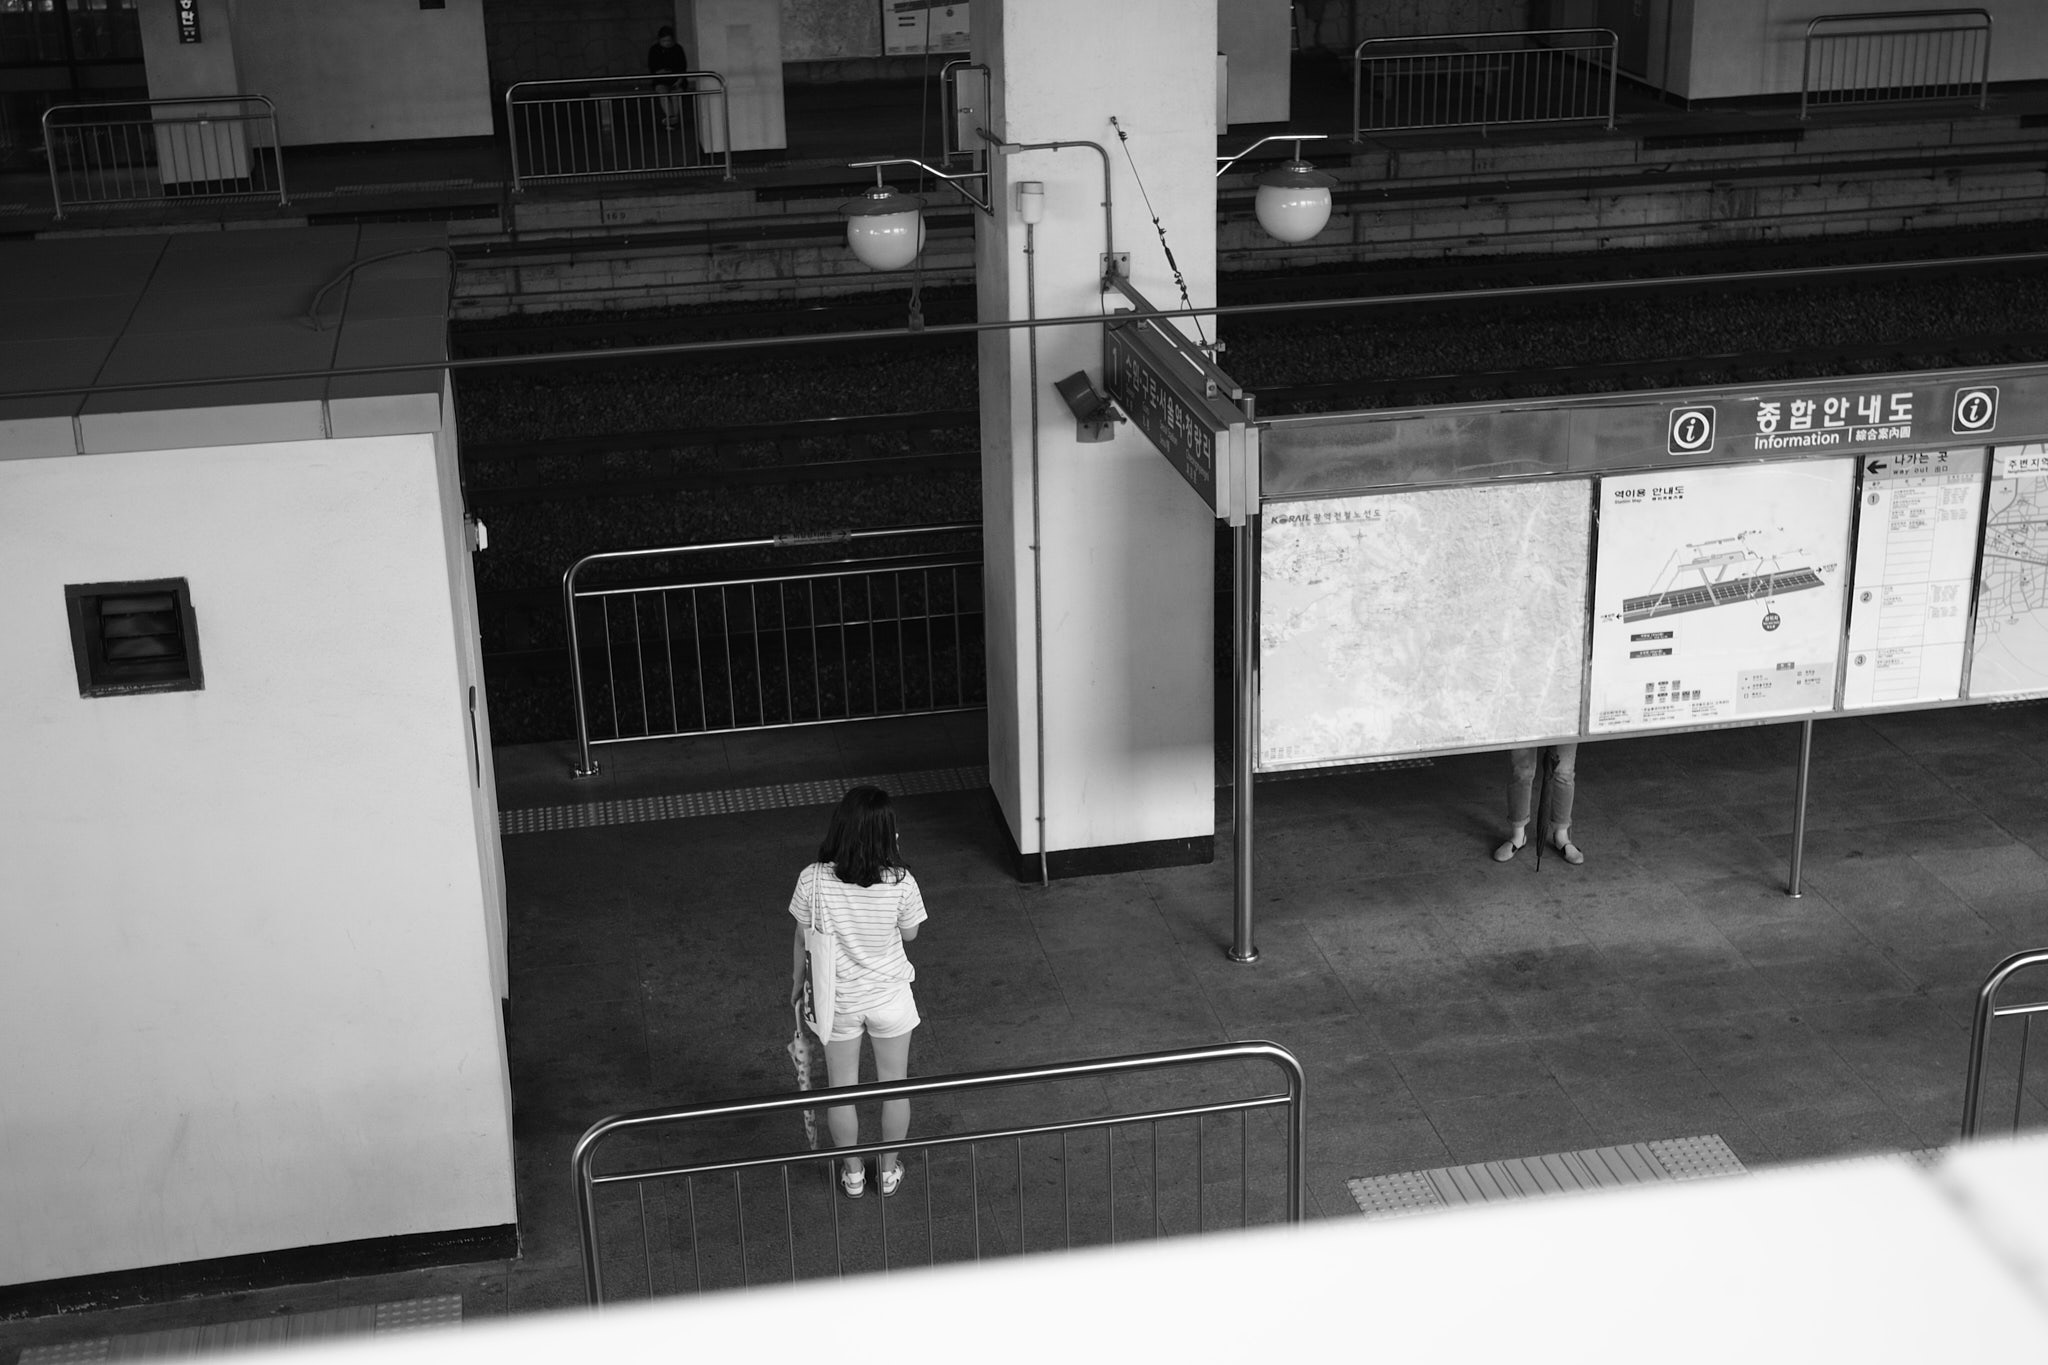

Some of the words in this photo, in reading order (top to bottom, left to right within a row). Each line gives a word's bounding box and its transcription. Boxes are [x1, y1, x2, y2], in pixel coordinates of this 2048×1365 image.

[1112, 346, 1119, 386] 1
[1756, 392, 1913, 433] 종합안내도
[1754, 431, 1840, 450] Information
[1894, 452, 1929, 465] 나가는
[1937, 451, 1948, 463] 곳
[1914, 466, 1929, 474] out
[1614, 488, 1646, 499] 역이용
[1652, 485, 1684, 496] 안내도
[1271, 513, 1310, 525] KORAIL
